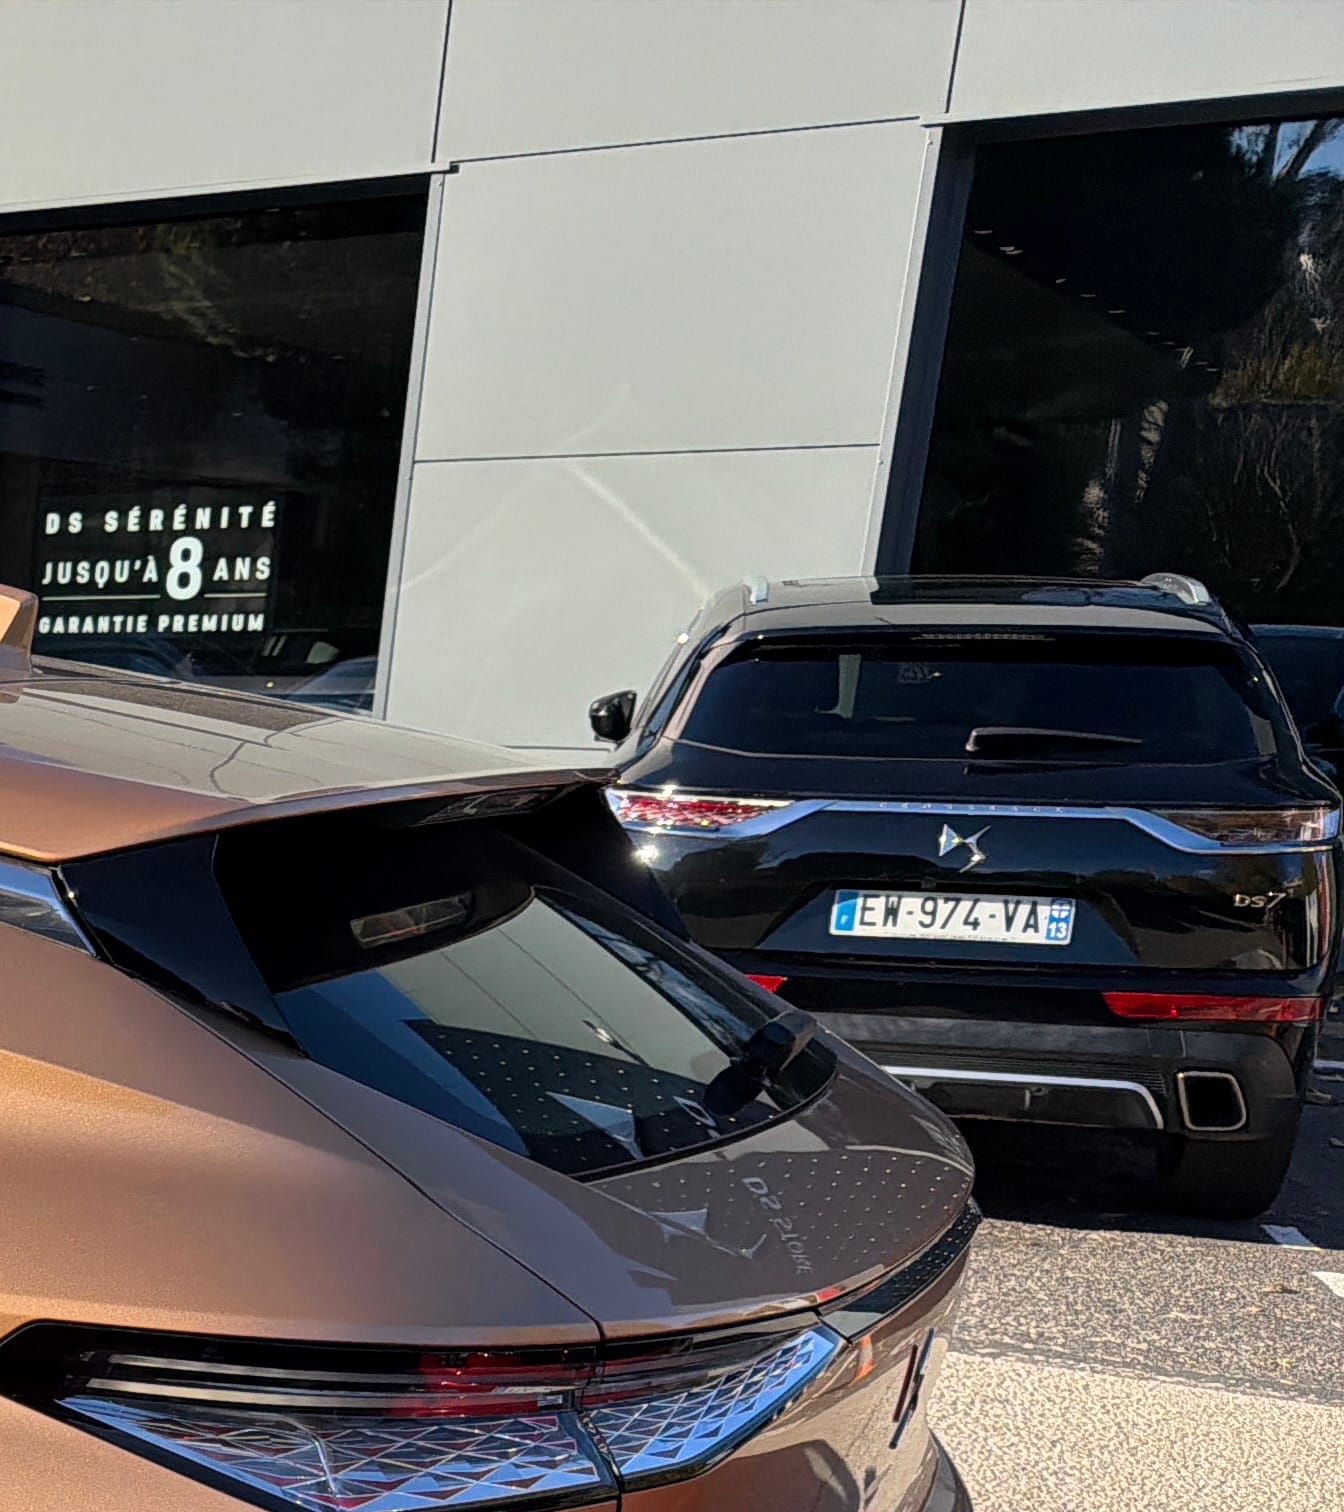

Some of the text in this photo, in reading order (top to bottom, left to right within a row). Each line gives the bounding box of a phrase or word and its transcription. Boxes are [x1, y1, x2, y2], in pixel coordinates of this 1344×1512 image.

[45, 500, 277, 535] DS SÉRÉNITÉ
[165, 536, 204, 600] 8
[212, 556, 272, 581] ANS
[38, 612, 265, 634] GARANTIE PREMIUM
[858, 893, 1041, 934] EW-974-VA
[1048, 921, 1067, 938] 13
